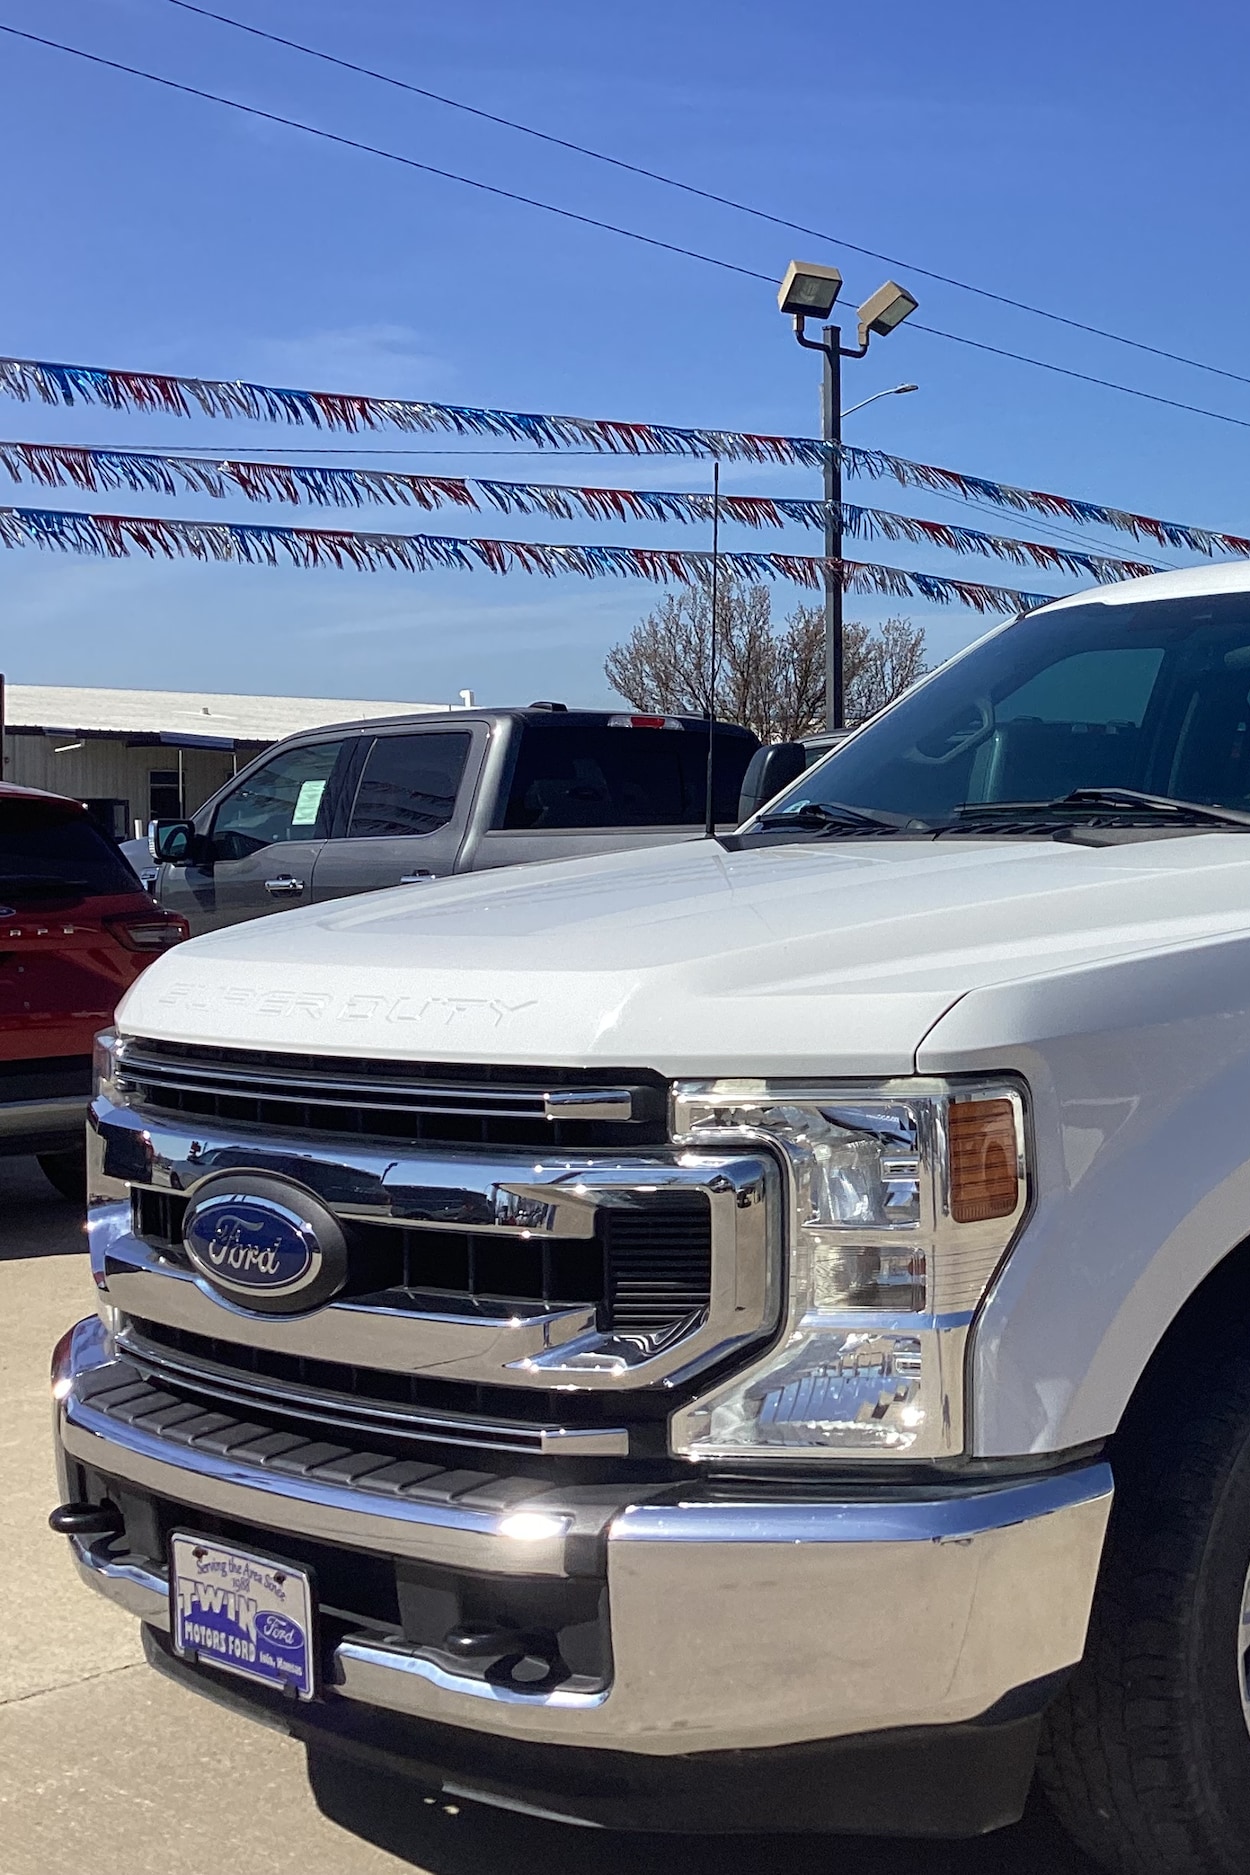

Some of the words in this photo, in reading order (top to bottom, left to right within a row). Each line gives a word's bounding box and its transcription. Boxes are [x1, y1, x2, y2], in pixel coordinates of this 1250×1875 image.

[337, 994, 539, 1027] DUTY
[208, 1214, 283, 1275] Ford
[229, 1556, 242, 1575] the
[243, 1563, 263, 1585] Area
[178, 1576, 257, 1645] TWIN
[185, 1620, 226, 1654] MOTORS
[228, 1635, 256, 1663] FORD
[263, 1615, 295, 1645] Ford
